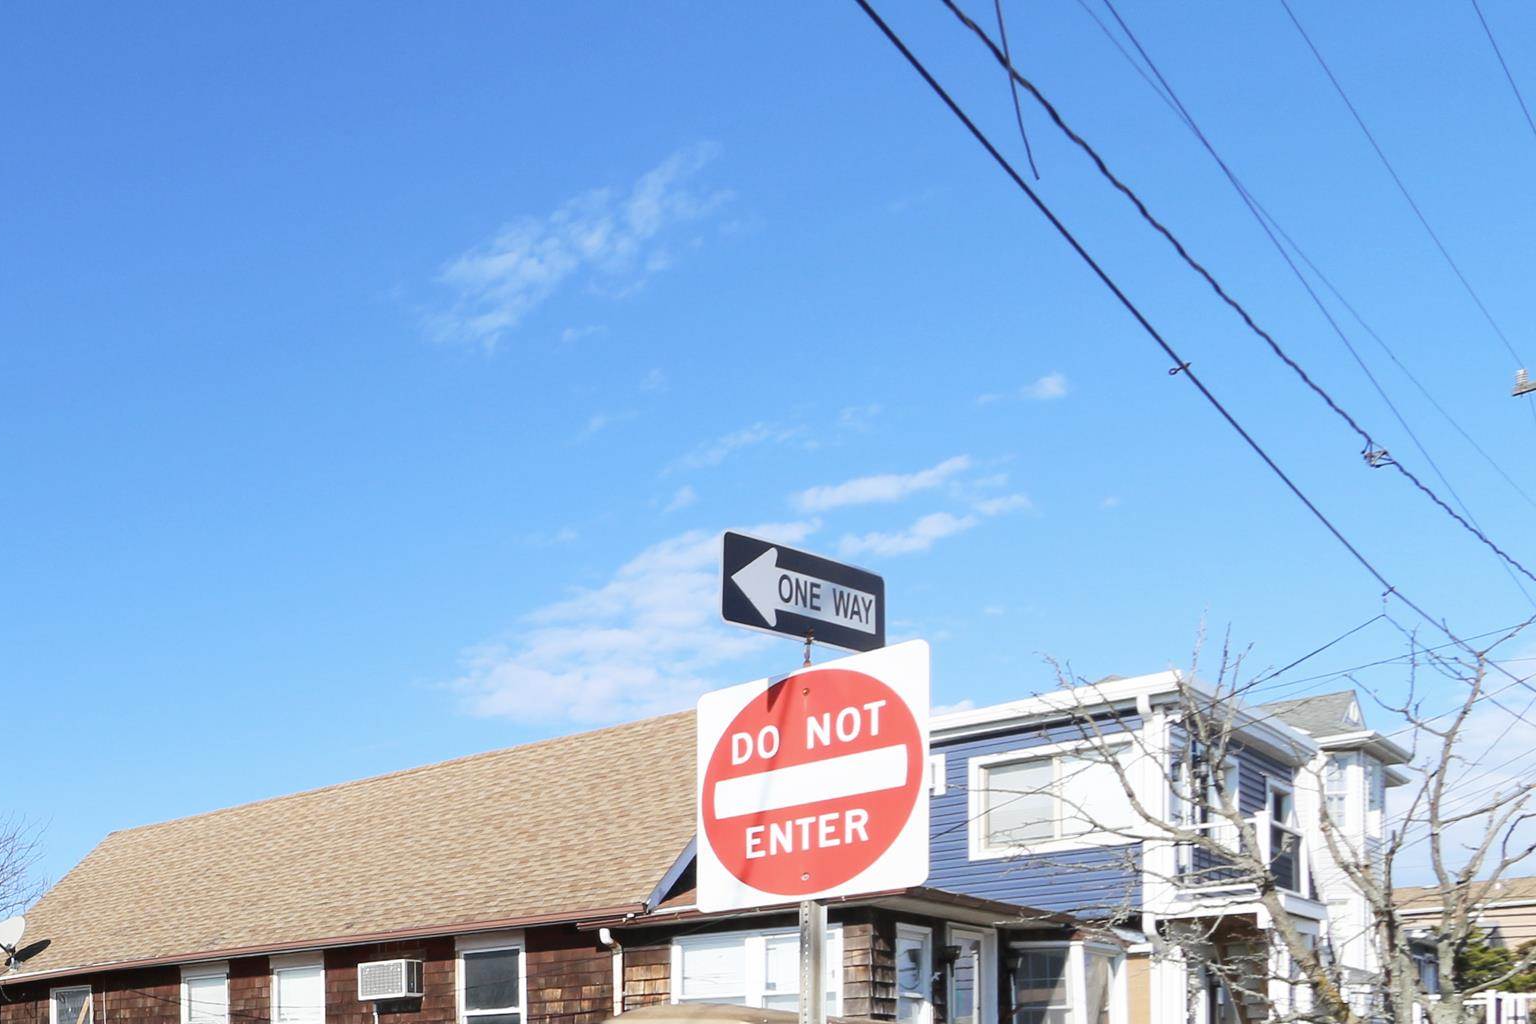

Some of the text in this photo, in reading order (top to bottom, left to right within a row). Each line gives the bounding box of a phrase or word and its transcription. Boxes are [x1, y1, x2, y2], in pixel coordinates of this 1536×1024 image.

[778, 574, 873, 625] ONE WAY
[731, 700, 886, 765] DO NOT
[745, 808, 869, 859] ENTER
